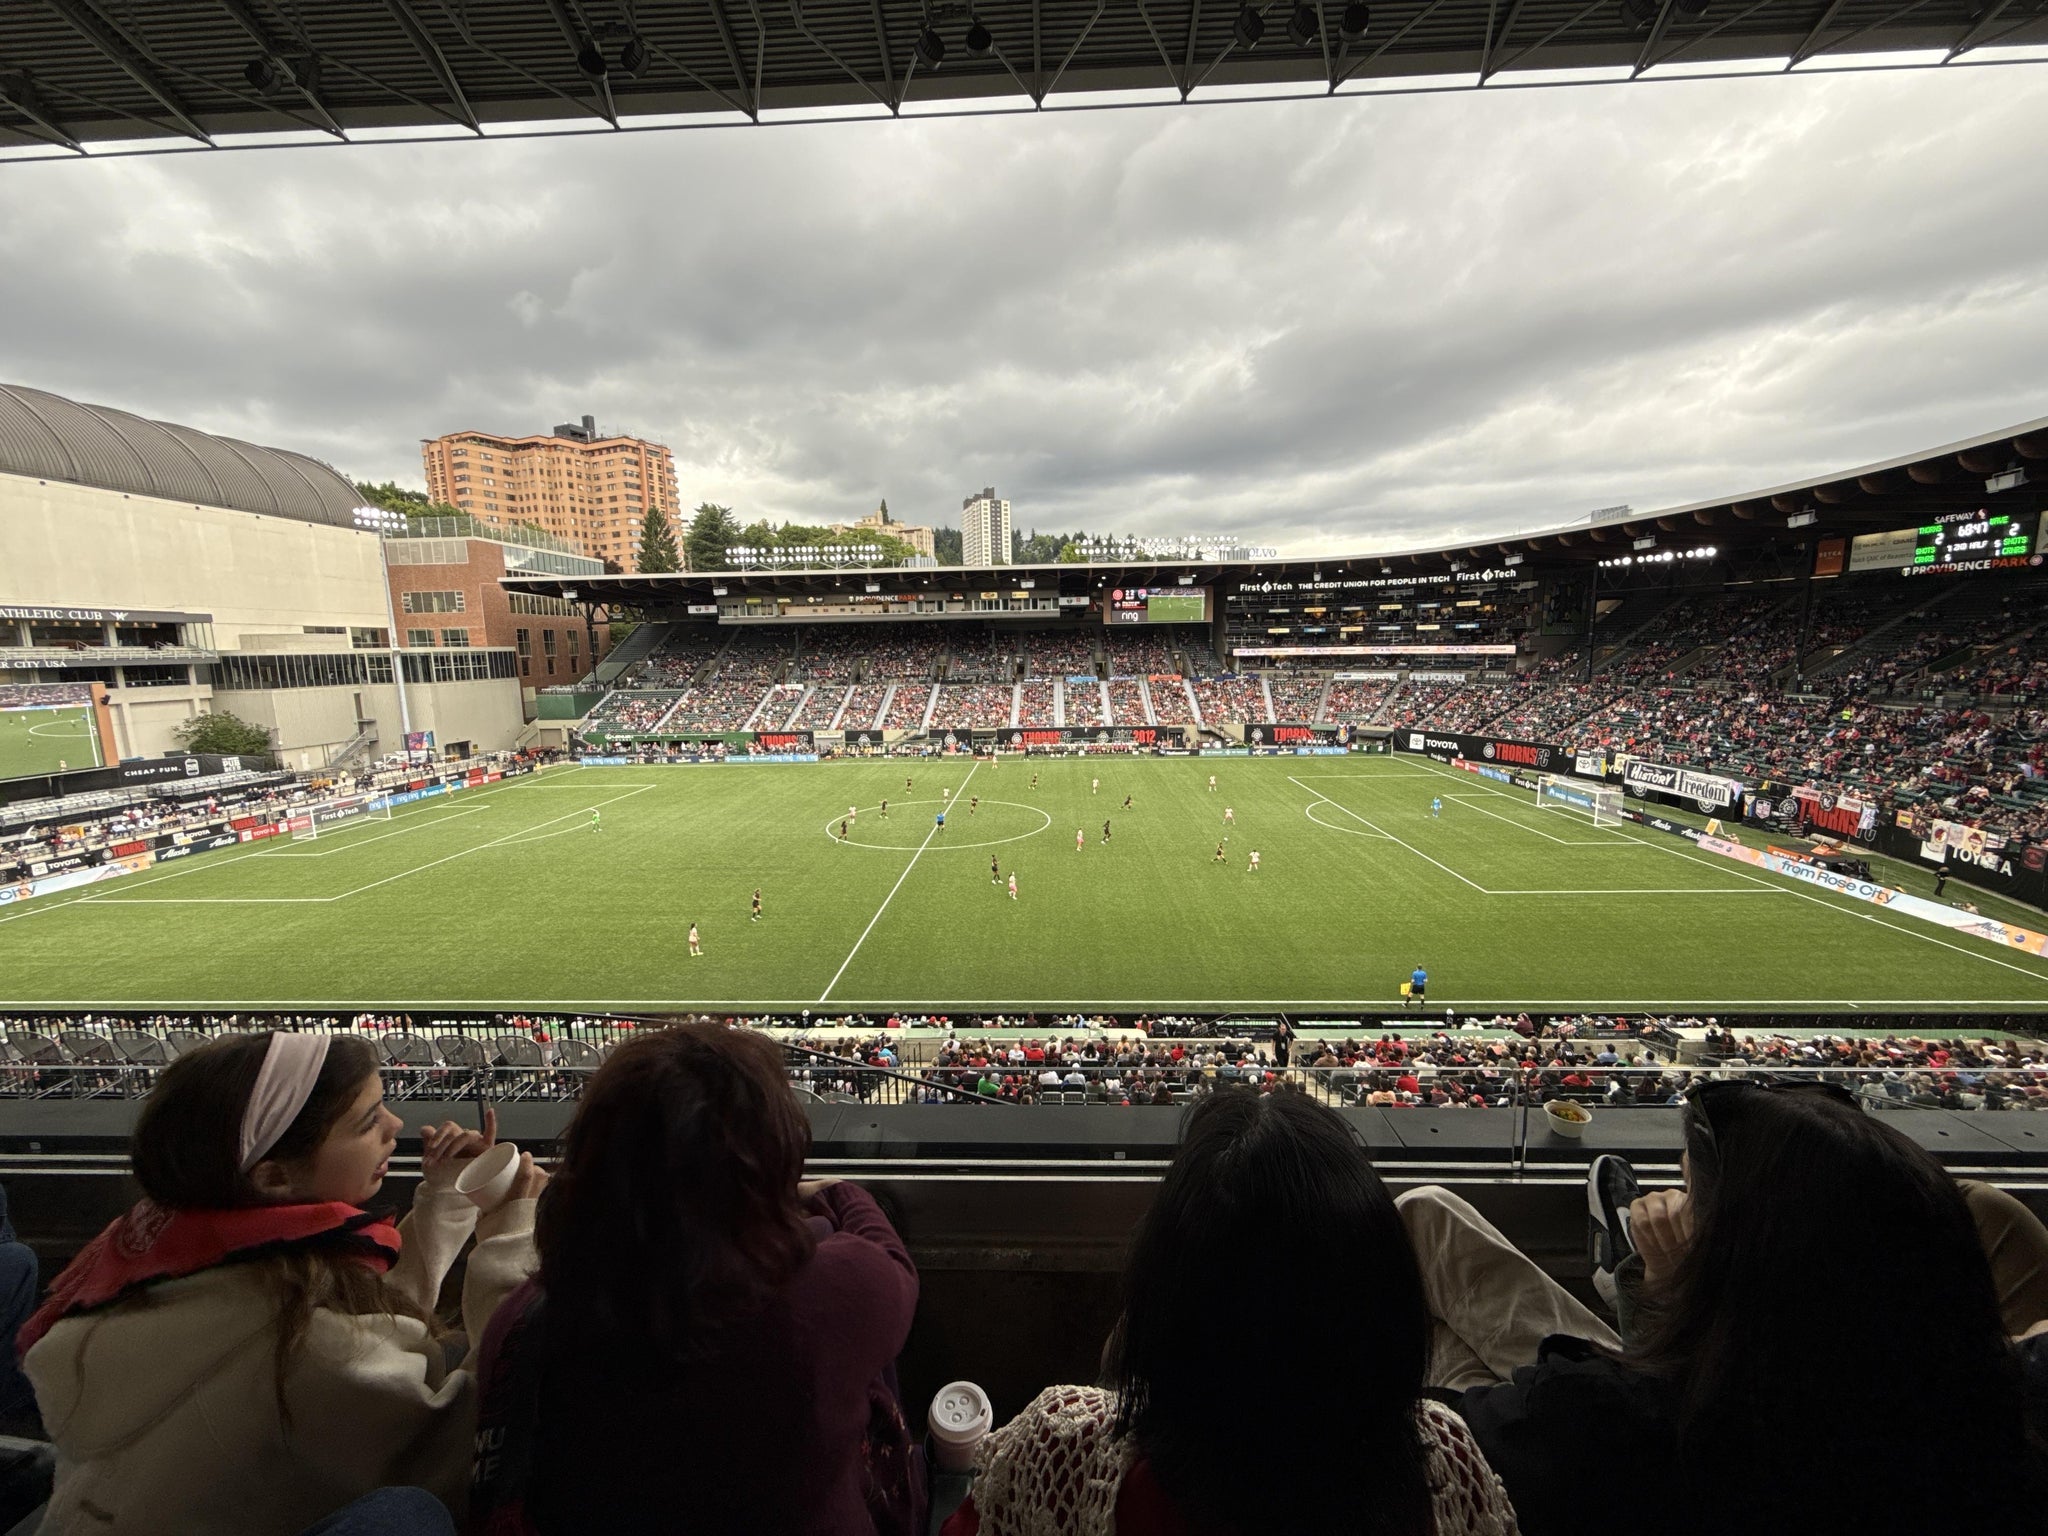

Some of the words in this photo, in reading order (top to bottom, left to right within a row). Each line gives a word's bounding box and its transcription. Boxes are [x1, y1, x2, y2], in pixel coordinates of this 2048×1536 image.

[1934, 511, 1975, 524] SAFEWAY
[1918, 524, 1943, 535] THORNS
[1989, 515, 2010, 526] WAVE
[1934, 533, 1944, 545] 2
[2009, 523, 2020, 536] 2
[1915, 546, 1936, 555] SHOTS
[1969, 540, 1988, 550] HALF
[2003, 536, 2028, 545] SHOTS
[1248, 548, 1277, 558] OLVO
[1912, 559, 1991, 575] PROVIDENCE
[1991, 556, 2028, 568] PARK
[1456, 572, 1480, 582] First
[1494, 569, 1516, 579] Tech
[1240, 583, 1260, 592] First
[1272, 582, 1292, 591] Tech
[1298, 582, 1313, 590] THE
[1314, 581, 1342, 590] CREDIT
[1343, 580, 1368, 588] UNION
[1370, 578, 1386, 586] FOR
[1387, 577, 1417, 586] PEOPLE
[0, 609, 63, 619] ATHLETIC
[69, 610, 103, 620] CLUB
[1122, 611, 1138, 621] ring
[14, 661, 40, 669] CITY
[45, 660, 67, 668] USA
[760, 735, 796, 748] THORNS
[1022, 731, 1060, 745] THORNS
[1132, 730, 1156, 744] 2012
[1425, 739, 1458, 750] TOYOTA
[1495, 742, 1537, 765] THORNS
[1534, 748, 1550, 767] FC
[222, 759, 240, 767] PUB
[124, 768, 156, 777] CHEAP
[1631, 764, 1675, 786] HISTORY
[1515, 778, 1525, 787] First
[1678, 770, 1726, 802] Freedom
[321, 812, 336, 820] First
[344, 807, 359, 816] Tech
[1650, 819, 1672, 831] Alaska
[185, 829, 210, 839] TOYOTA
[1680, 828, 1701, 841] Alask
[111, 840, 146, 857] THORNS
[208, 836, 236, 848] Alaska
[161, 846, 191, 860] Alaska
[48, 858, 81, 870] TOYOTA
[1952, 847, 2012, 877] TOYA
[1781, 860, 1816, 879] from
[1816, 873, 1857, 892] Rose
[1859, 885, 1897, 905] City
[1976, 922, 2009, 936] Alaska
